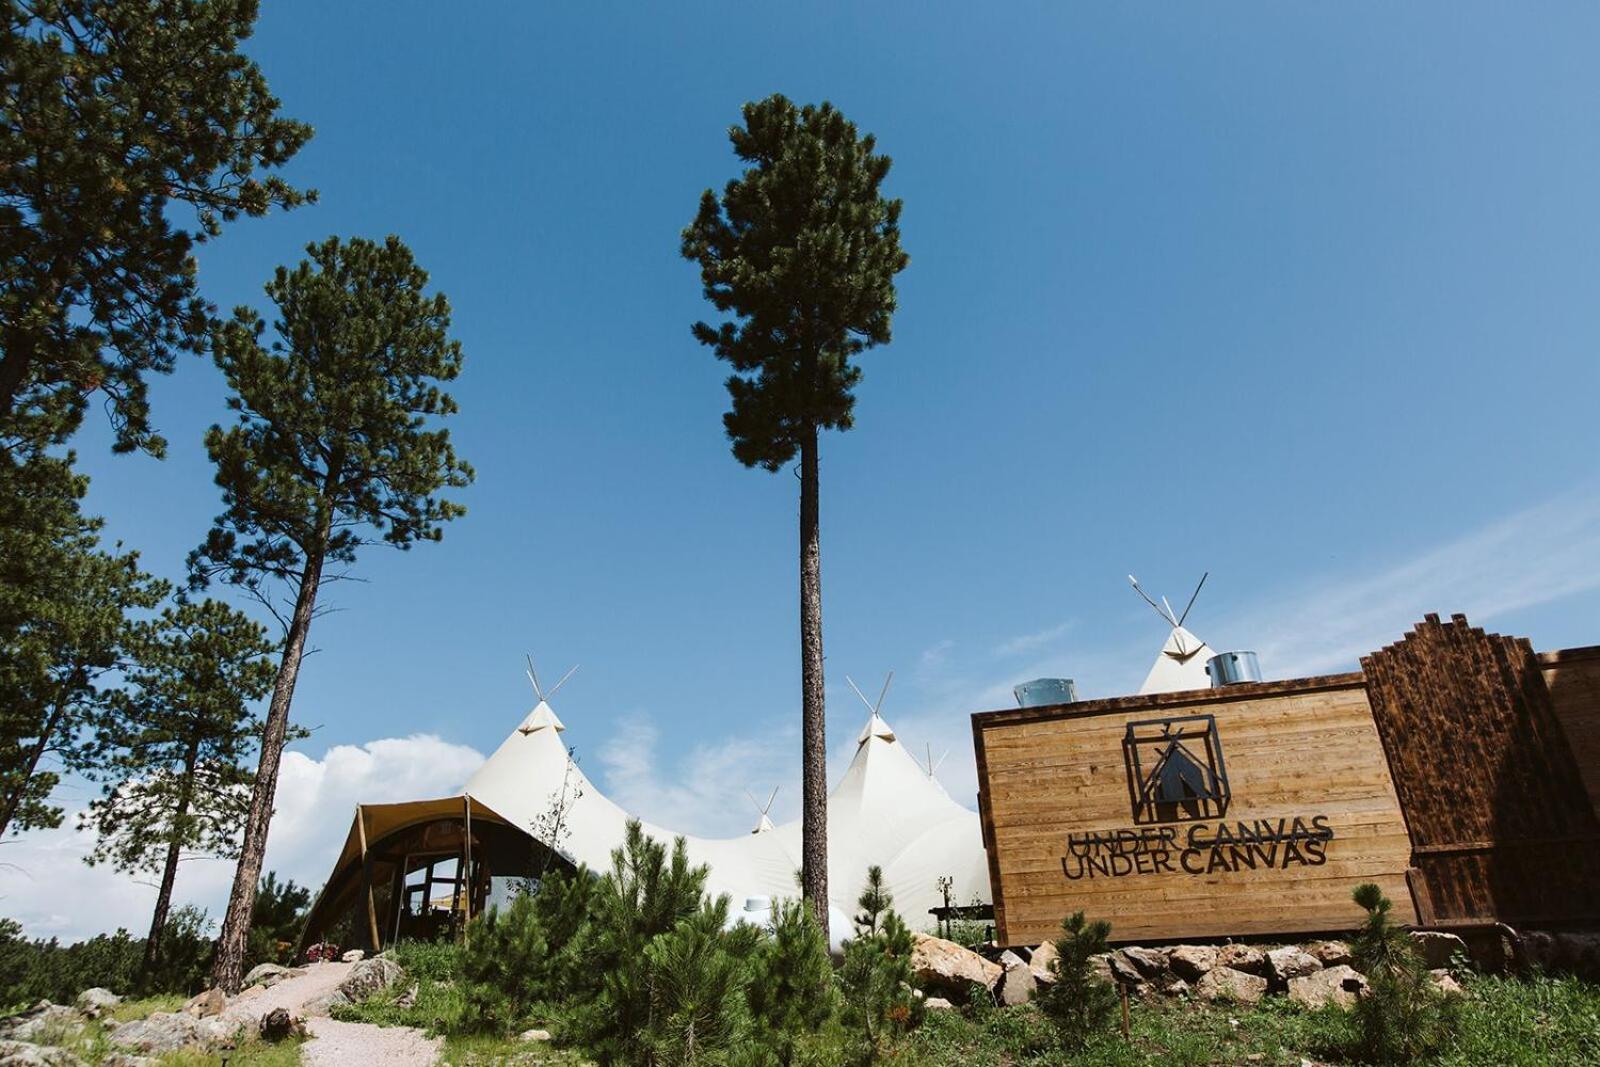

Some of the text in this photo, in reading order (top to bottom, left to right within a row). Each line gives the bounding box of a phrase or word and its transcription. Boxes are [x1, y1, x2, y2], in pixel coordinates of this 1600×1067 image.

[1068, 815, 1334, 858] UNDER CANVAS
[1061, 840, 1328, 880] UNDER CANVAS
